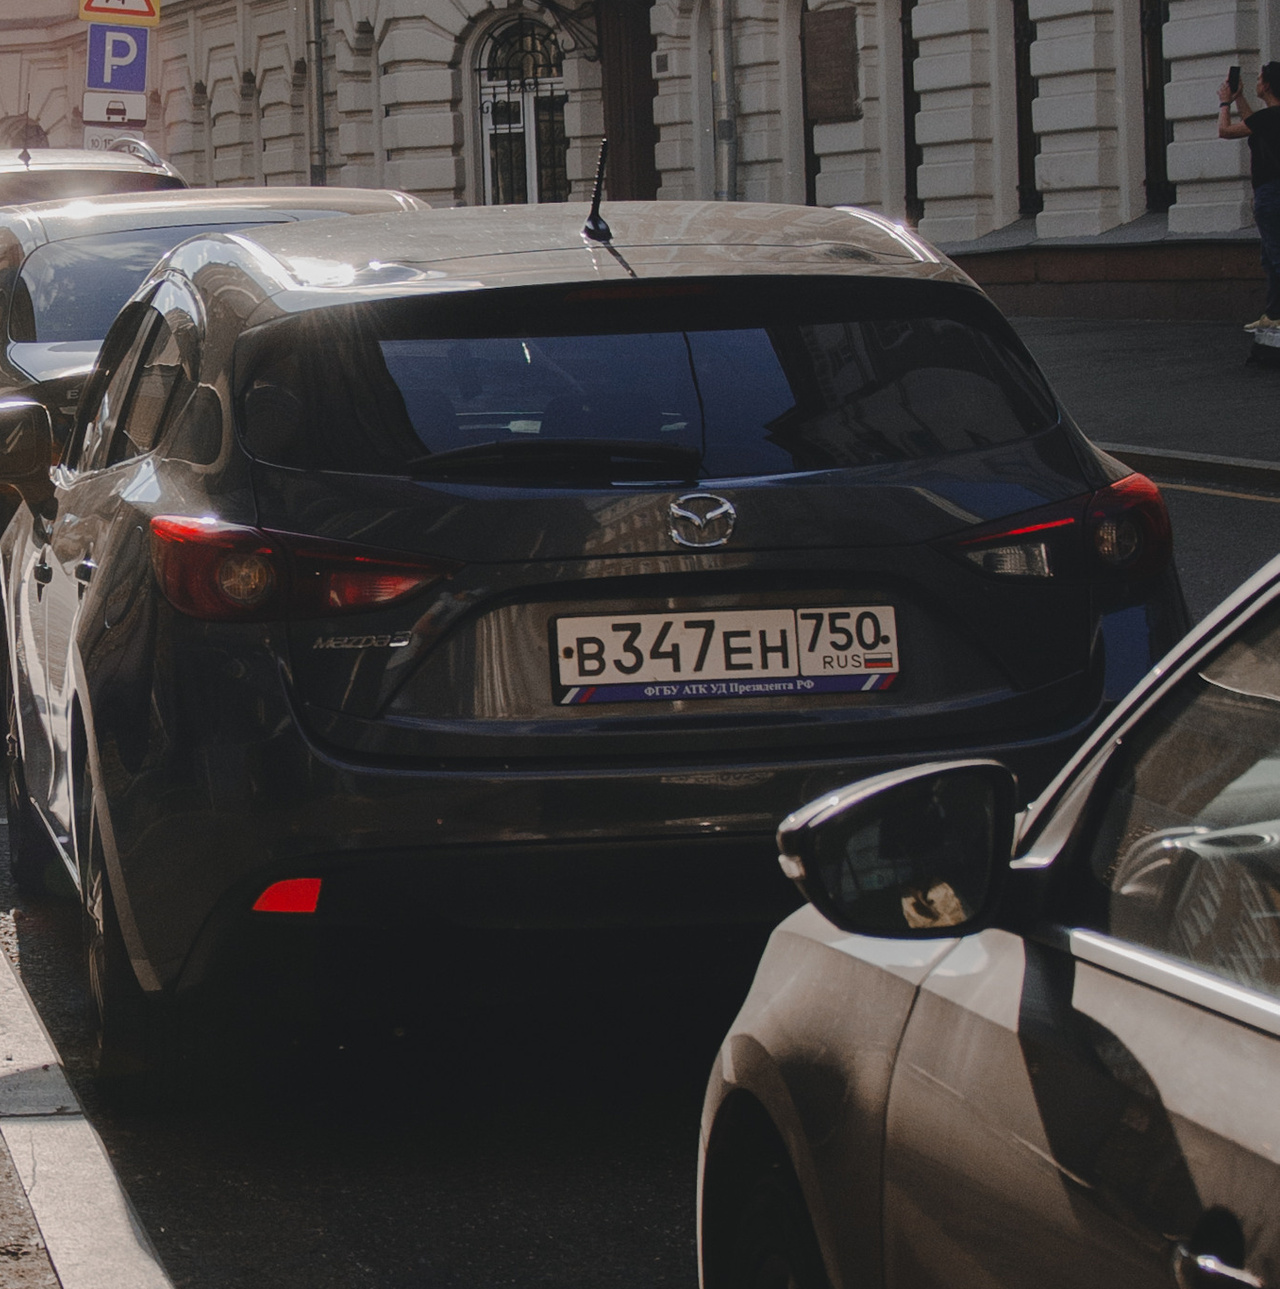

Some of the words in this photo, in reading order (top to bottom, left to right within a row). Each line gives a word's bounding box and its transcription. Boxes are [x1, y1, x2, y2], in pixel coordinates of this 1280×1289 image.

[103, 31, 138, 83] P
[576, 619, 789, 677] В347ЕН
[800, 611, 881, 653] 750
[823, 654, 862, 669] RUS
[644, 685, 679, 697] ФГБУ
[682, 684, 708, 695] АТК
[730, 681, 794, 695] Президента
[796, 679, 815, 690] РФ
